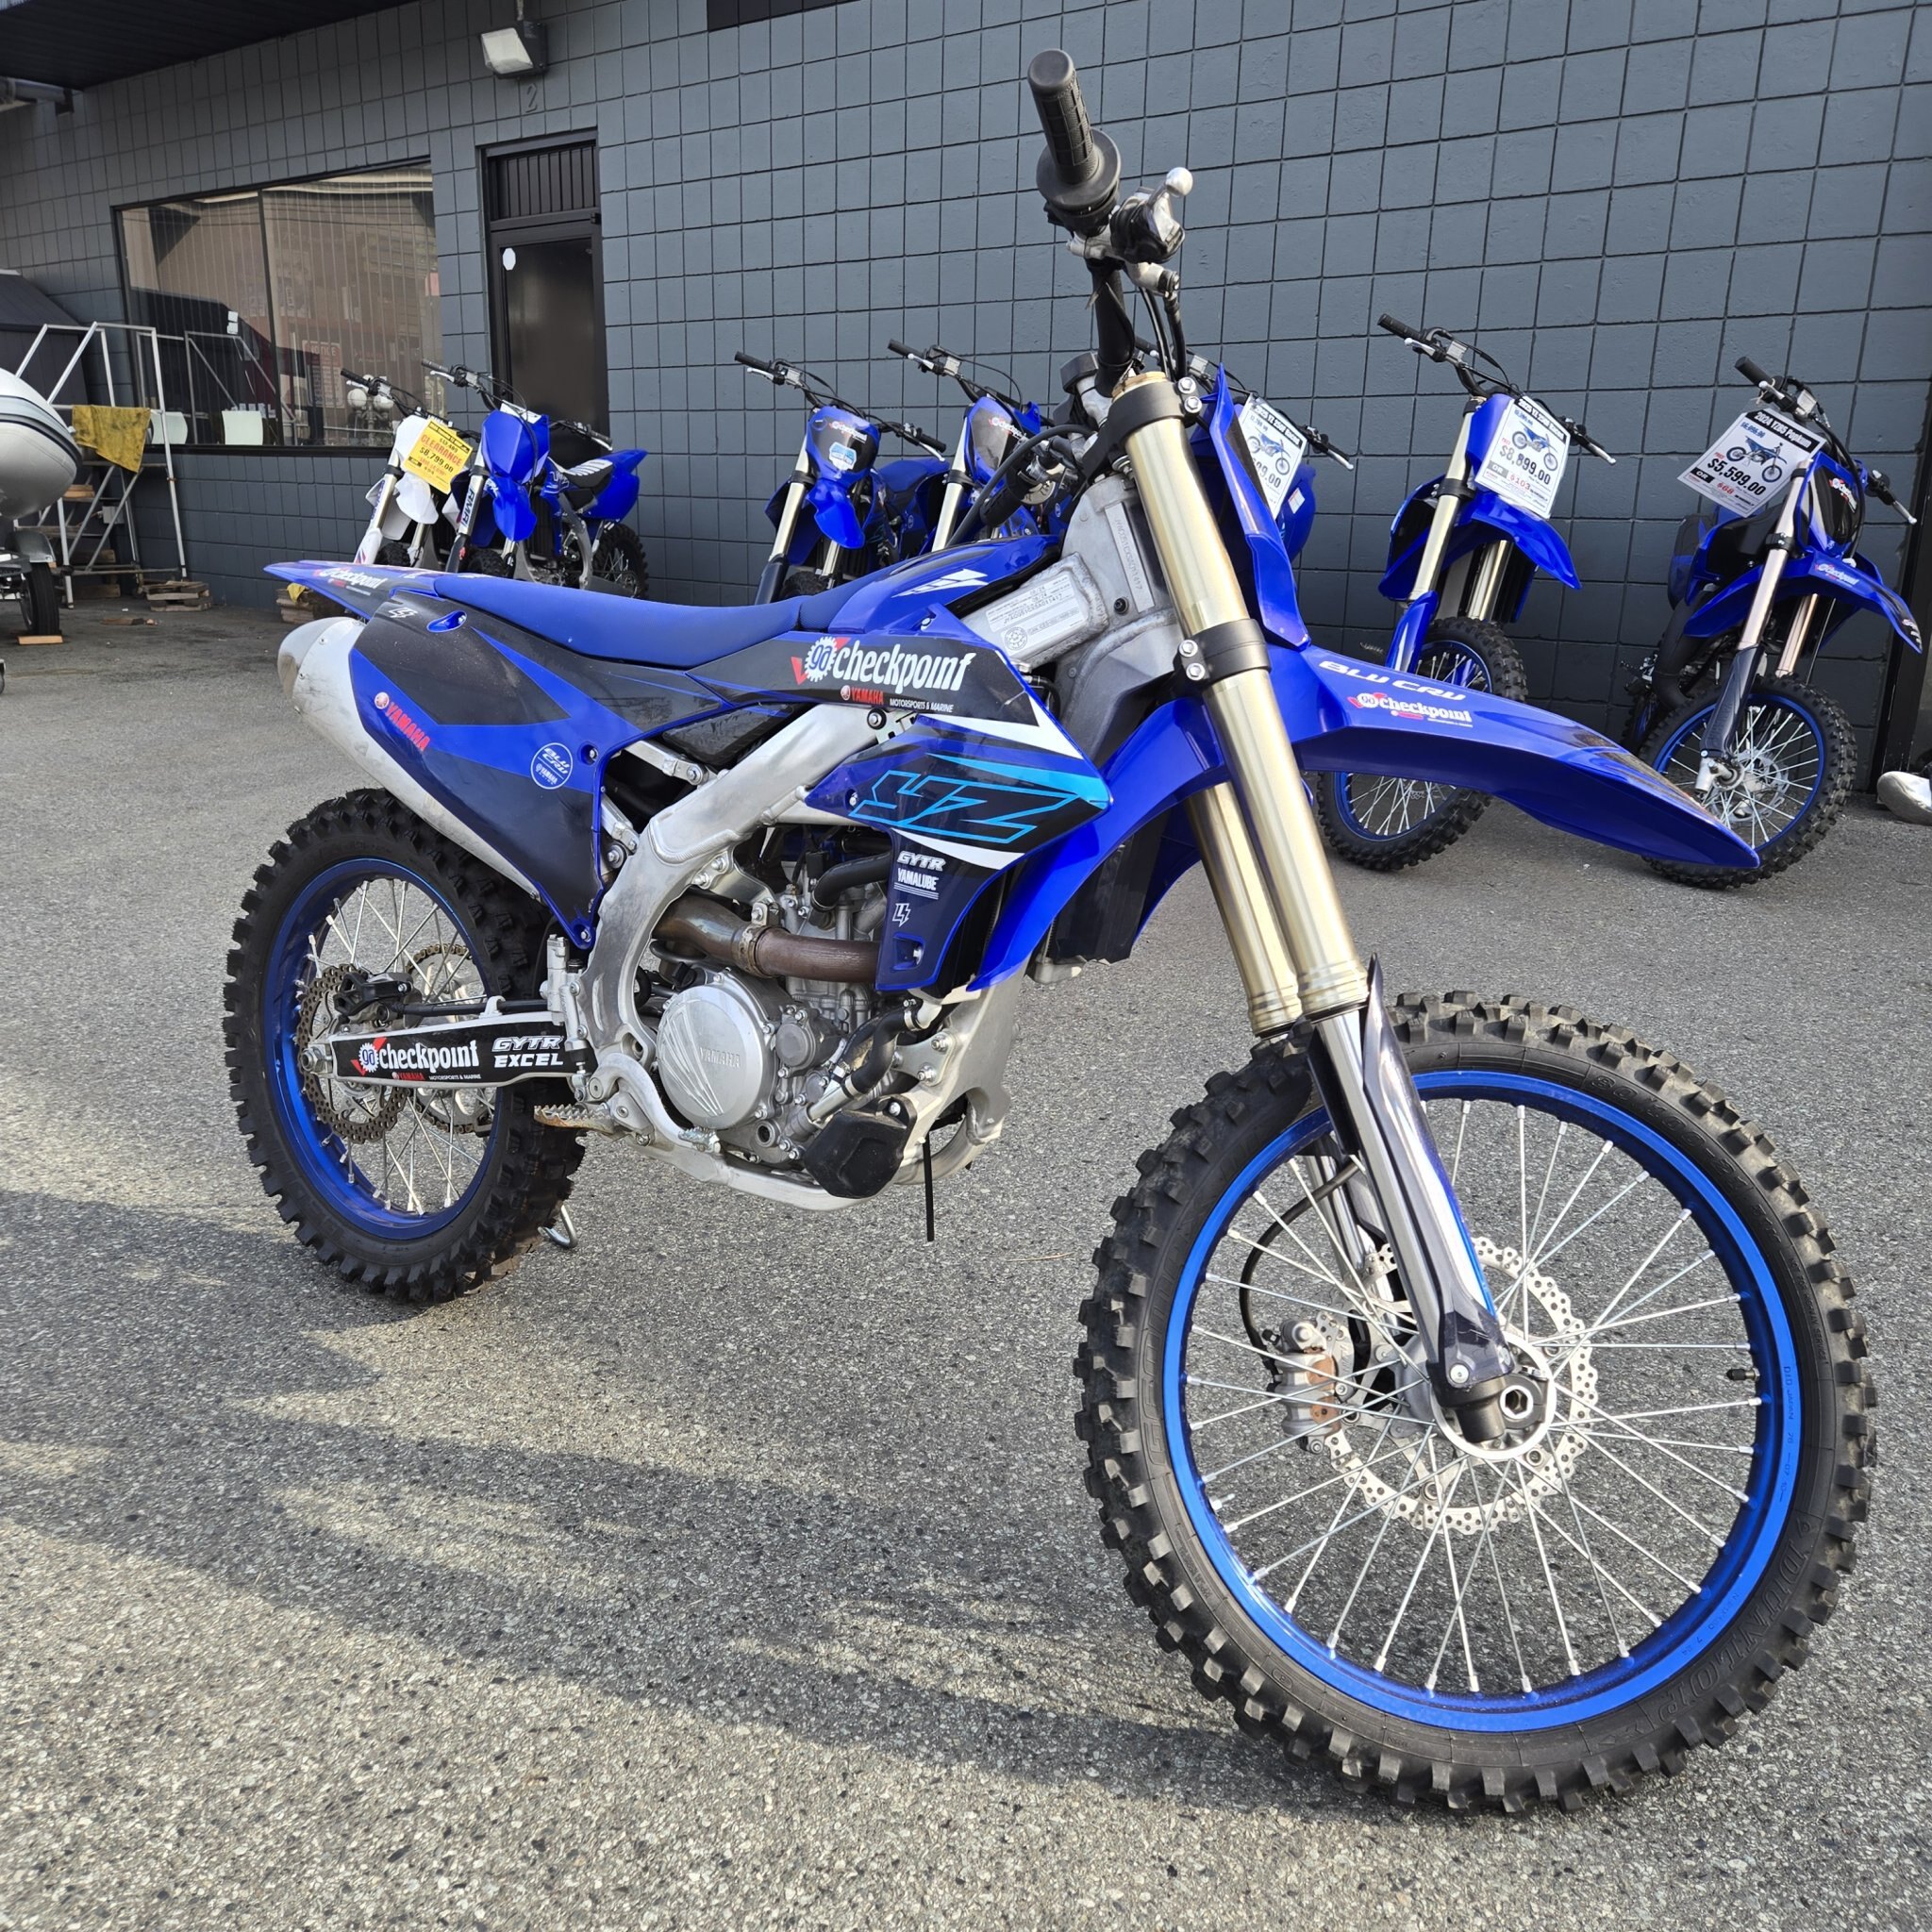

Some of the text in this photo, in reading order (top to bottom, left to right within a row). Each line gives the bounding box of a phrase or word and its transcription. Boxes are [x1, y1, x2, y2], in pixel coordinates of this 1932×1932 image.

[525, 82, 538, 113] 2
[1755, 411, 1774, 427] 2024
[419, 446, 454, 474] $8,799.00
[421, 434, 463, 466] CLEARANCE
[1491, 464, 1504, 475] OR
[1499, 444, 1552, 485] $8,899.00
[1695, 471, 1709, 481] OR
[1707, 458, 1767, 496] $5,599.00
[832, 640, 977, 694] checkpoint
[1319, 661, 1467, 701] BLU CRU
[851, 687, 885, 705] YAMAHA
[890, 698, 925, 709] MOTORSPORTS
[931, 703, 955, 713] MARINE
[1379, 697, 1473, 723] checkpoint
[385, 701, 431, 753] YAMAHA
[849, 770, 1081, 843] YZ
[896, 850, 946, 872] GYTR
[897, 867, 938, 891] YAMALUBE
[378, 1040, 479, 1074] checkpoint
[491, 1036, 565, 1052] GYTR
[493, 1053, 564, 1069] EXCEL
[699, 1046, 741, 1069] YAMAHA
[397, 1072, 425, 1081] YAMAHA
[1649, 1538, 1812, 1724] DUNLOP
